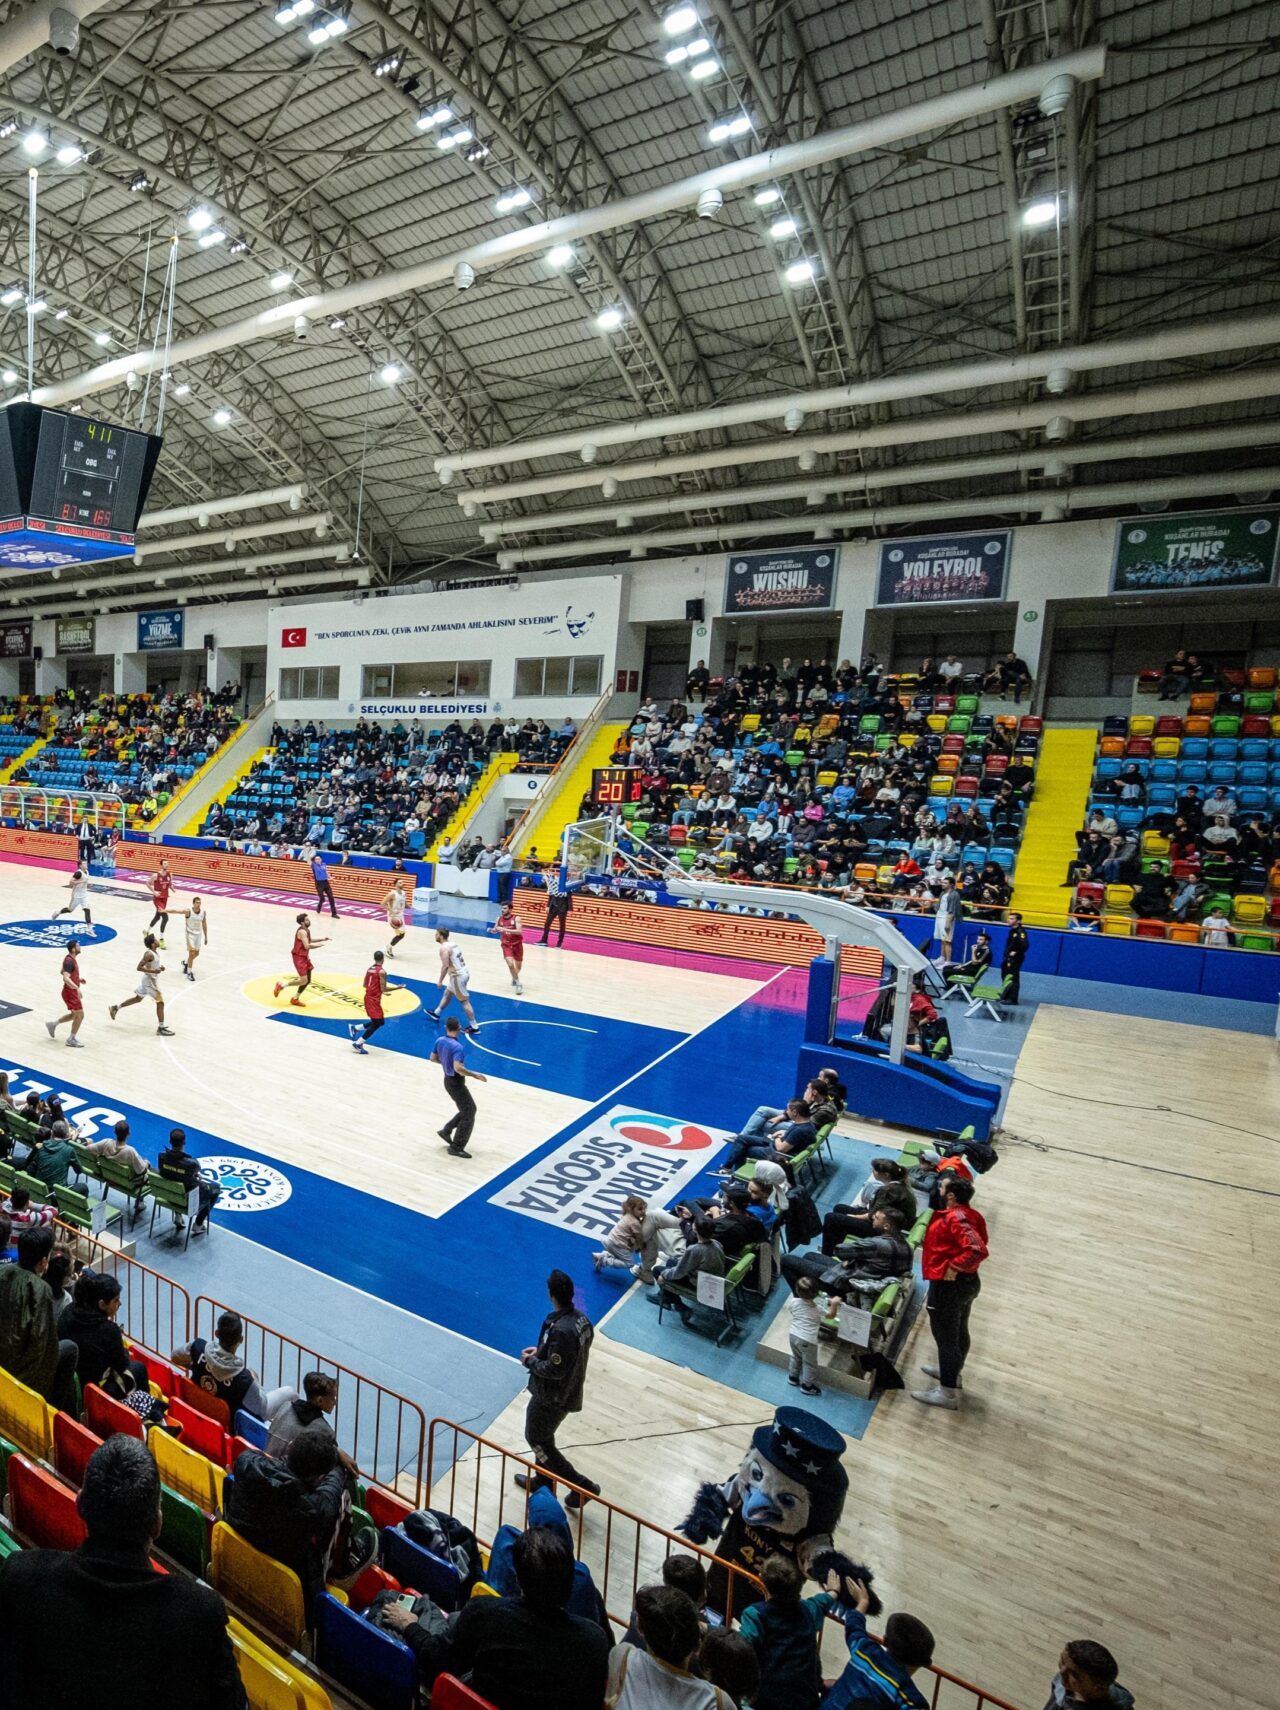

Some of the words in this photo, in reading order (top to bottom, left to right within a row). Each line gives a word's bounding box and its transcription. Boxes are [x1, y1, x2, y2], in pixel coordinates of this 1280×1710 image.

[360, 704, 416, 716] SELÇUKLU
[419, 702, 487, 714] BELEDİYESİ
[598, 783, 623, 801] 20
[506, 1136, 633, 1214] SİGORTA
[563, 1152, 688, 1236] TÜRKİYE
